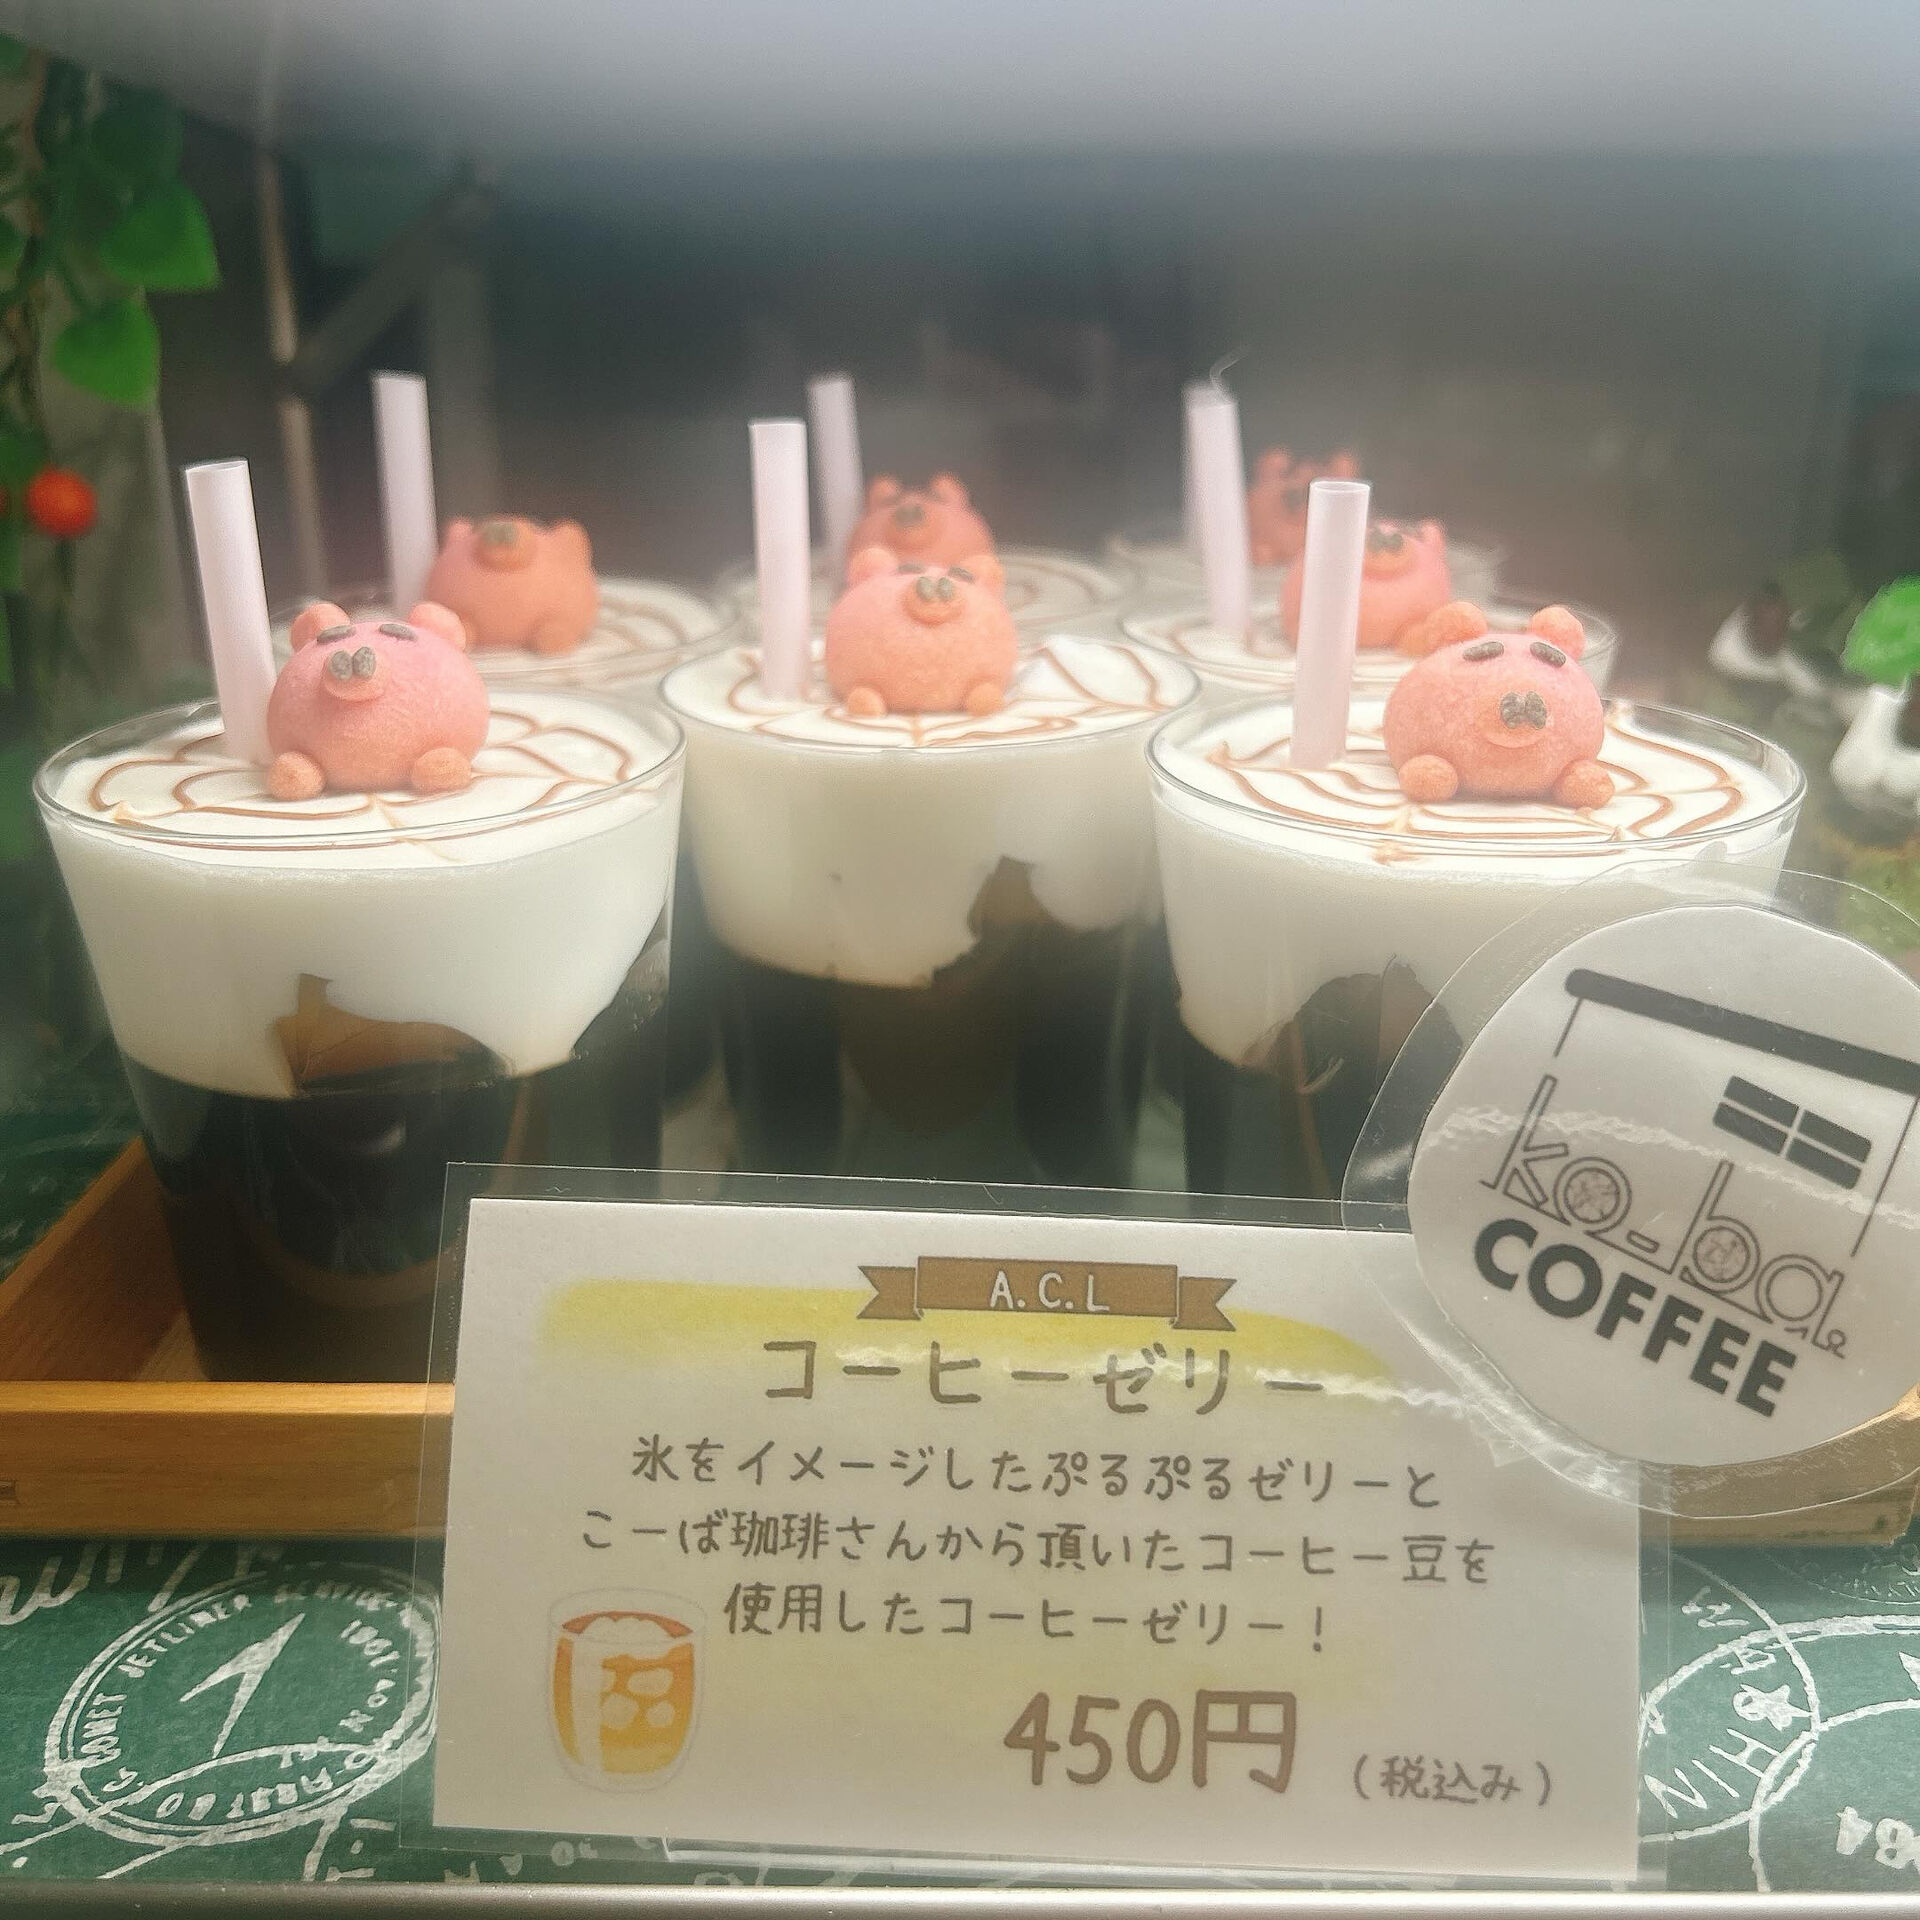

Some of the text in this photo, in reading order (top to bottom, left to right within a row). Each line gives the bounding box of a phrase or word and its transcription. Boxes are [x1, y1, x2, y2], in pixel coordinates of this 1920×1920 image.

[989, 1271, 1110, 1313] A.C.L
[1474, 1217, 1798, 1418] COFFEE
[763, 1340, 1325, 1416] コーヒーゼリー
[632, 1434, 1440, 1508] 氷をイメージしたぷるぷるゼリーと
[583, 1508, 1495, 1584] こーば珈琲さんから頂いたコーヒー豆を
[723, 1582, 1323, 1653] 使用したコーヒーゼリー！
[1003, 1689, 1298, 1793] 450円
[1353, 1753, 1551, 1806] （税込み）
